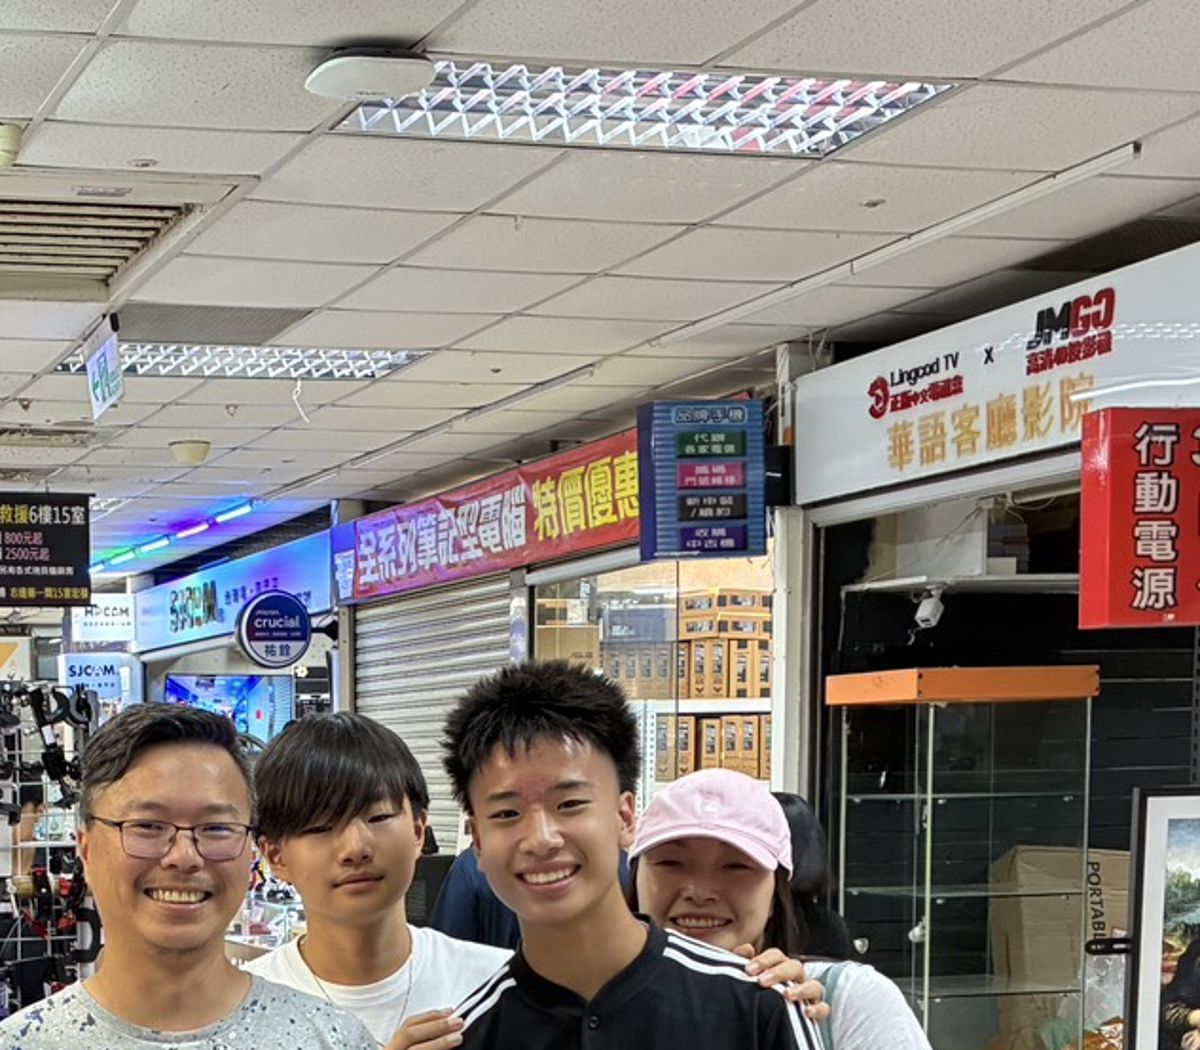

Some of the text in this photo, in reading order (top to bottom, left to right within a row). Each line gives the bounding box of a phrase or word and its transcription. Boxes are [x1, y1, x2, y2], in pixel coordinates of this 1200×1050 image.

[1026, 287, 1116, 350] JMGO
[943, 351, 960, 371] TV
[1131, 422, 1179, 610] 行動電源
[255, 616, 301, 629] crucial
